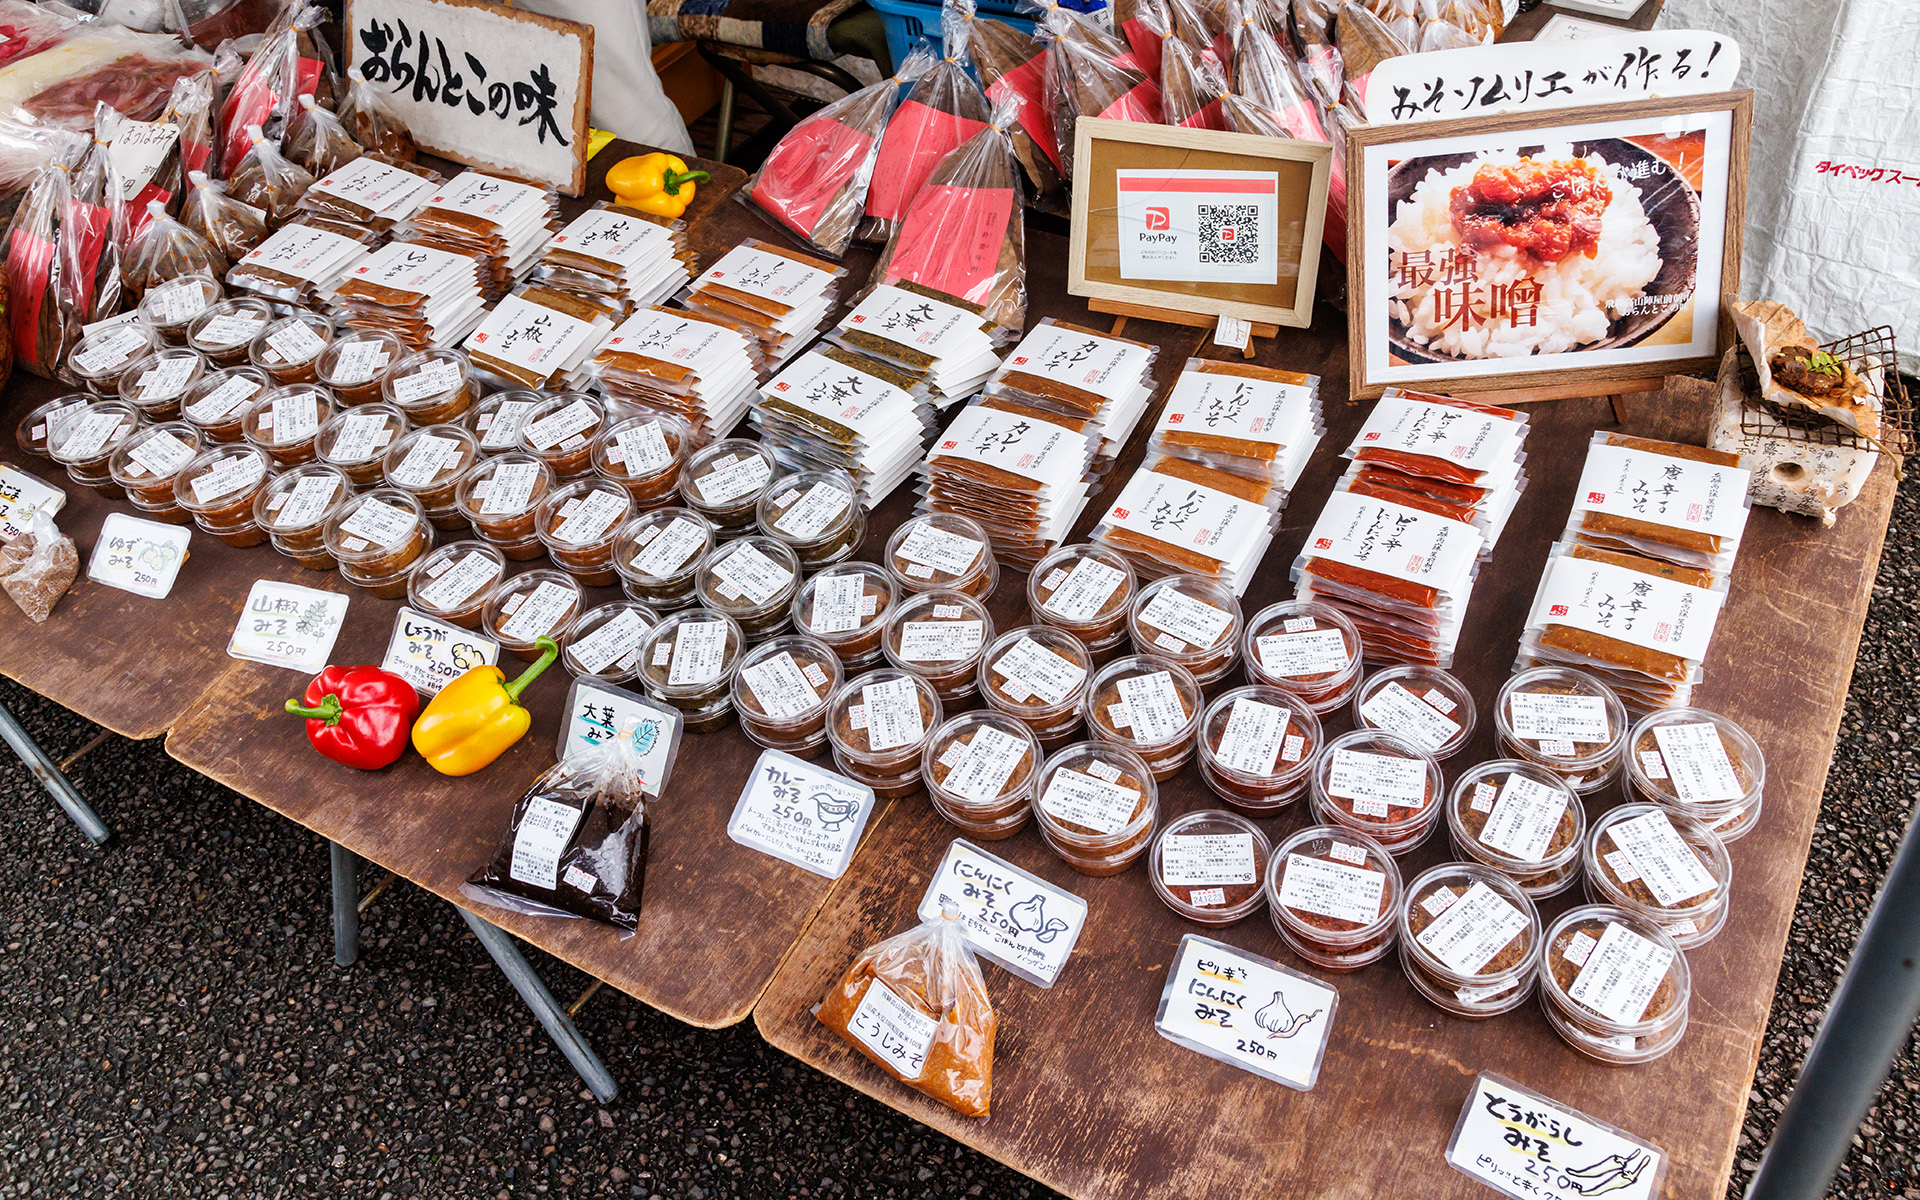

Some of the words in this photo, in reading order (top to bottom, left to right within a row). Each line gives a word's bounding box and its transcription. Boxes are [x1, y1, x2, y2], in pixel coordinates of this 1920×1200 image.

[360, 18, 570, 147] おらんとこの味
[1139, 232, 1177, 244] PayPay
[1397, 249, 1479, 289] 最強
[1434, 277, 1544, 332] 味噌
[521, 315, 552, 343] 山椒
[1067, 340, 1100, 370] カレー
[1205, 397, 1224, 428] みそ
[1222, 382, 1254, 424] にんにく
[999, 421, 1032, 453] カレー
[1427, 411, 1462, 443] ピリ辛
[1169, 489, 1207, 531] にんにく
[1632, 479, 1650, 514] みそ
[1150, 501, 1172, 531] みそ
[109, 537, 142, 551] ゆず
[1381, 513, 1418, 553] ピリ辛
[108, 555, 133, 569] みそ
[134, 572, 157, 585] 250円
[252, 595, 299, 614] 山椒
[1597, 593, 1617, 629] みそ
[253, 619, 288, 635] みそ
[405, 621, 448, 642] しょうが
[266, 641, 307, 656] 250円
[409, 641, 433, 660] みそ
[428, 660, 461, 678] 250円
[583, 703, 615, 728] 大葉
[765, 766, 806, 785] カレー
[773, 786, 801, 804] みそ
[772, 804, 812, 827] 250円
[954, 860, 1014, 895] にんにく
[963, 883, 996, 908] みそ
[978, 908, 1020, 938] 250円
[994, 933, 1046, 960] ごはんとの相性
[1188, 978, 1247, 1009] にんにく
[1195, 1003, 1233, 1028] みそ
[856, 1013, 923, 1069] こうじみそ
[1236, 1039, 1277, 1060] 250円
[1483, 1091, 1583, 1147] とうがらし
[1504, 1126, 1551, 1163] みそ
[1525, 1159, 1582, 1193] 250円
